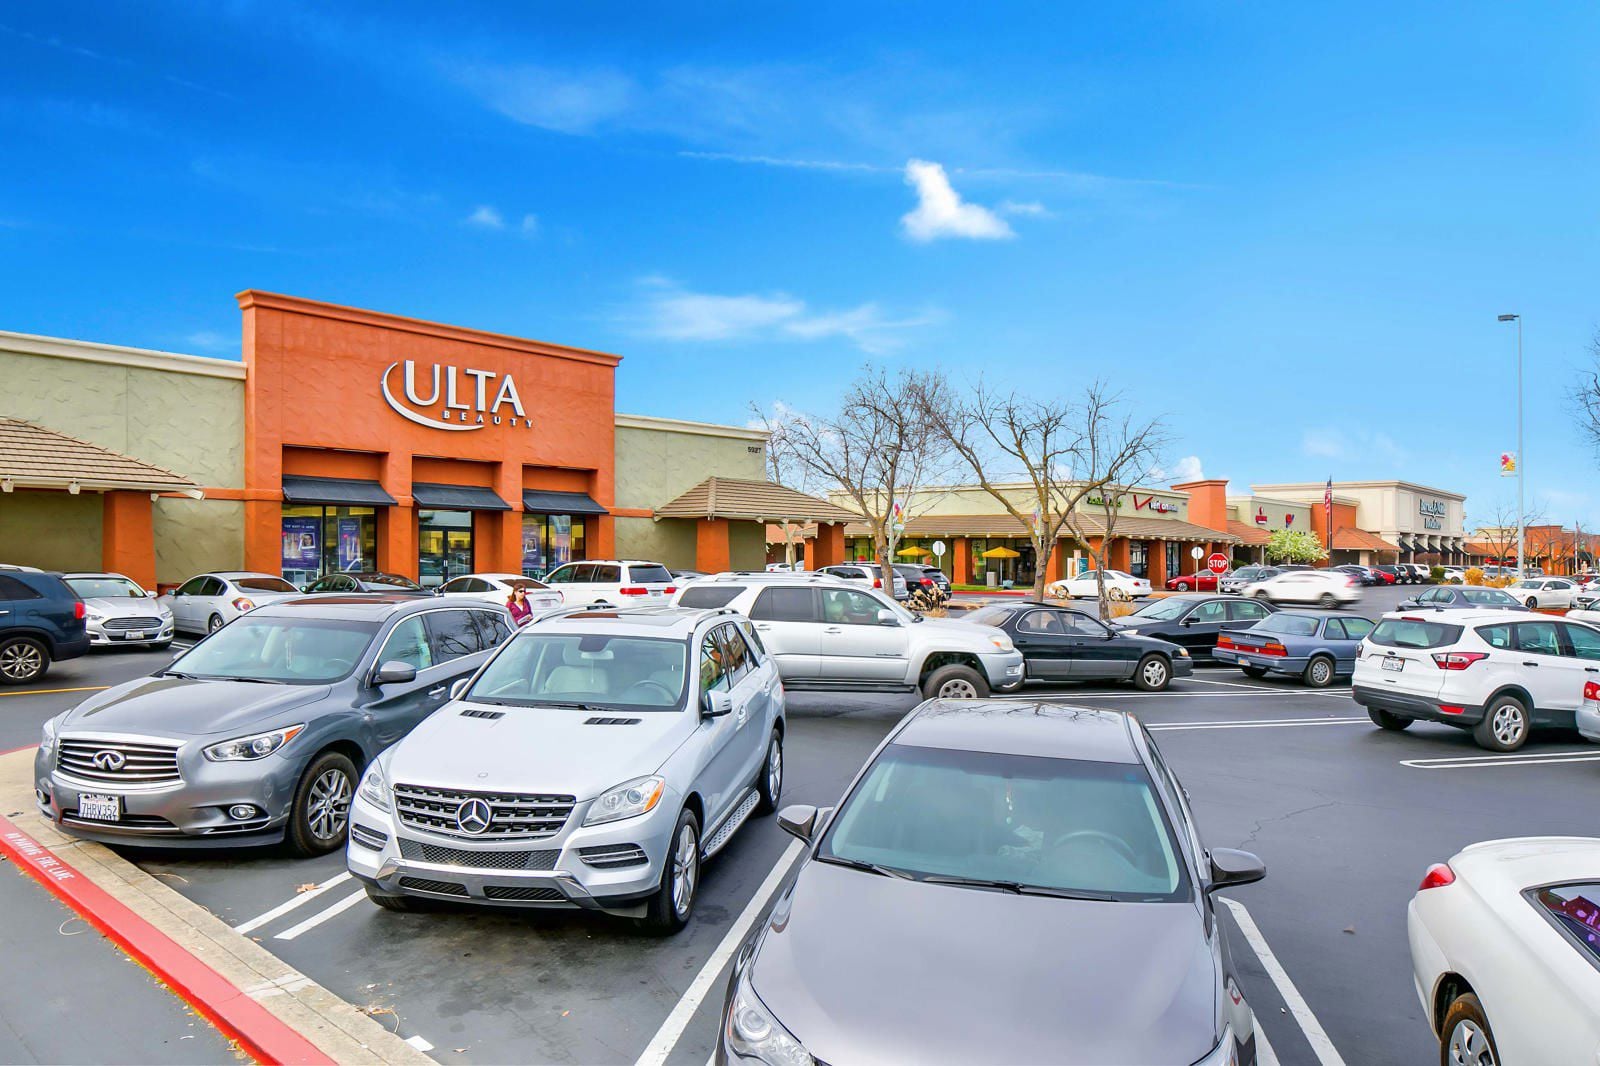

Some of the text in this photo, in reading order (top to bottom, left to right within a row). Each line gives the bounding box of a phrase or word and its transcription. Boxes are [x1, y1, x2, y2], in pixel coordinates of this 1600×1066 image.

[404, 359, 526, 417] ULTA
[442, 410, 533, 428] BEAUTY
[1209, 559, 1227, 568] STOP
[33, 855, 60, 868] FIRE
[48, 866, 75, 880] LANE
